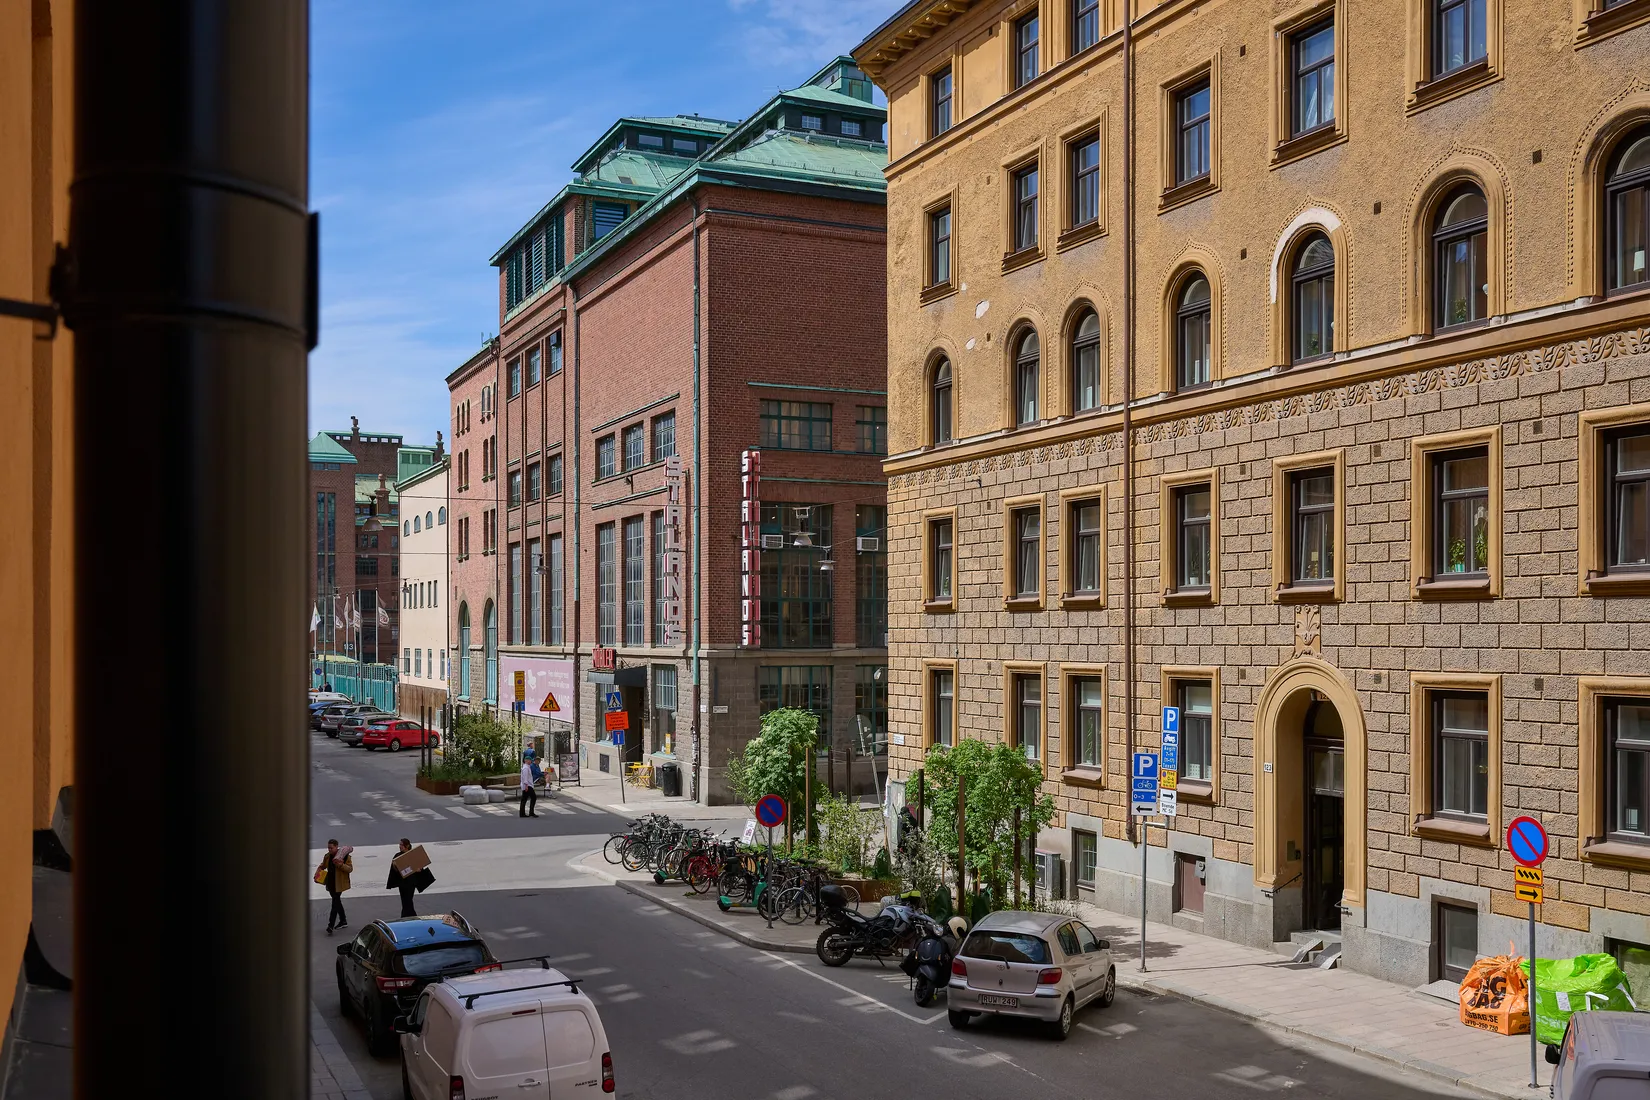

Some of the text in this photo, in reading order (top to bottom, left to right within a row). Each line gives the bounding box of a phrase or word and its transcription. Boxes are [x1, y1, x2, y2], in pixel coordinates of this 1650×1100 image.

[665, 456, 683, 646] STALANDS
[741, 450, 755, 646] STALANDS
[1166, 709, 1176, 729] P
[1139, 755, 1154, 775] P
[983, 995, 1016, 1006] RUW 249
